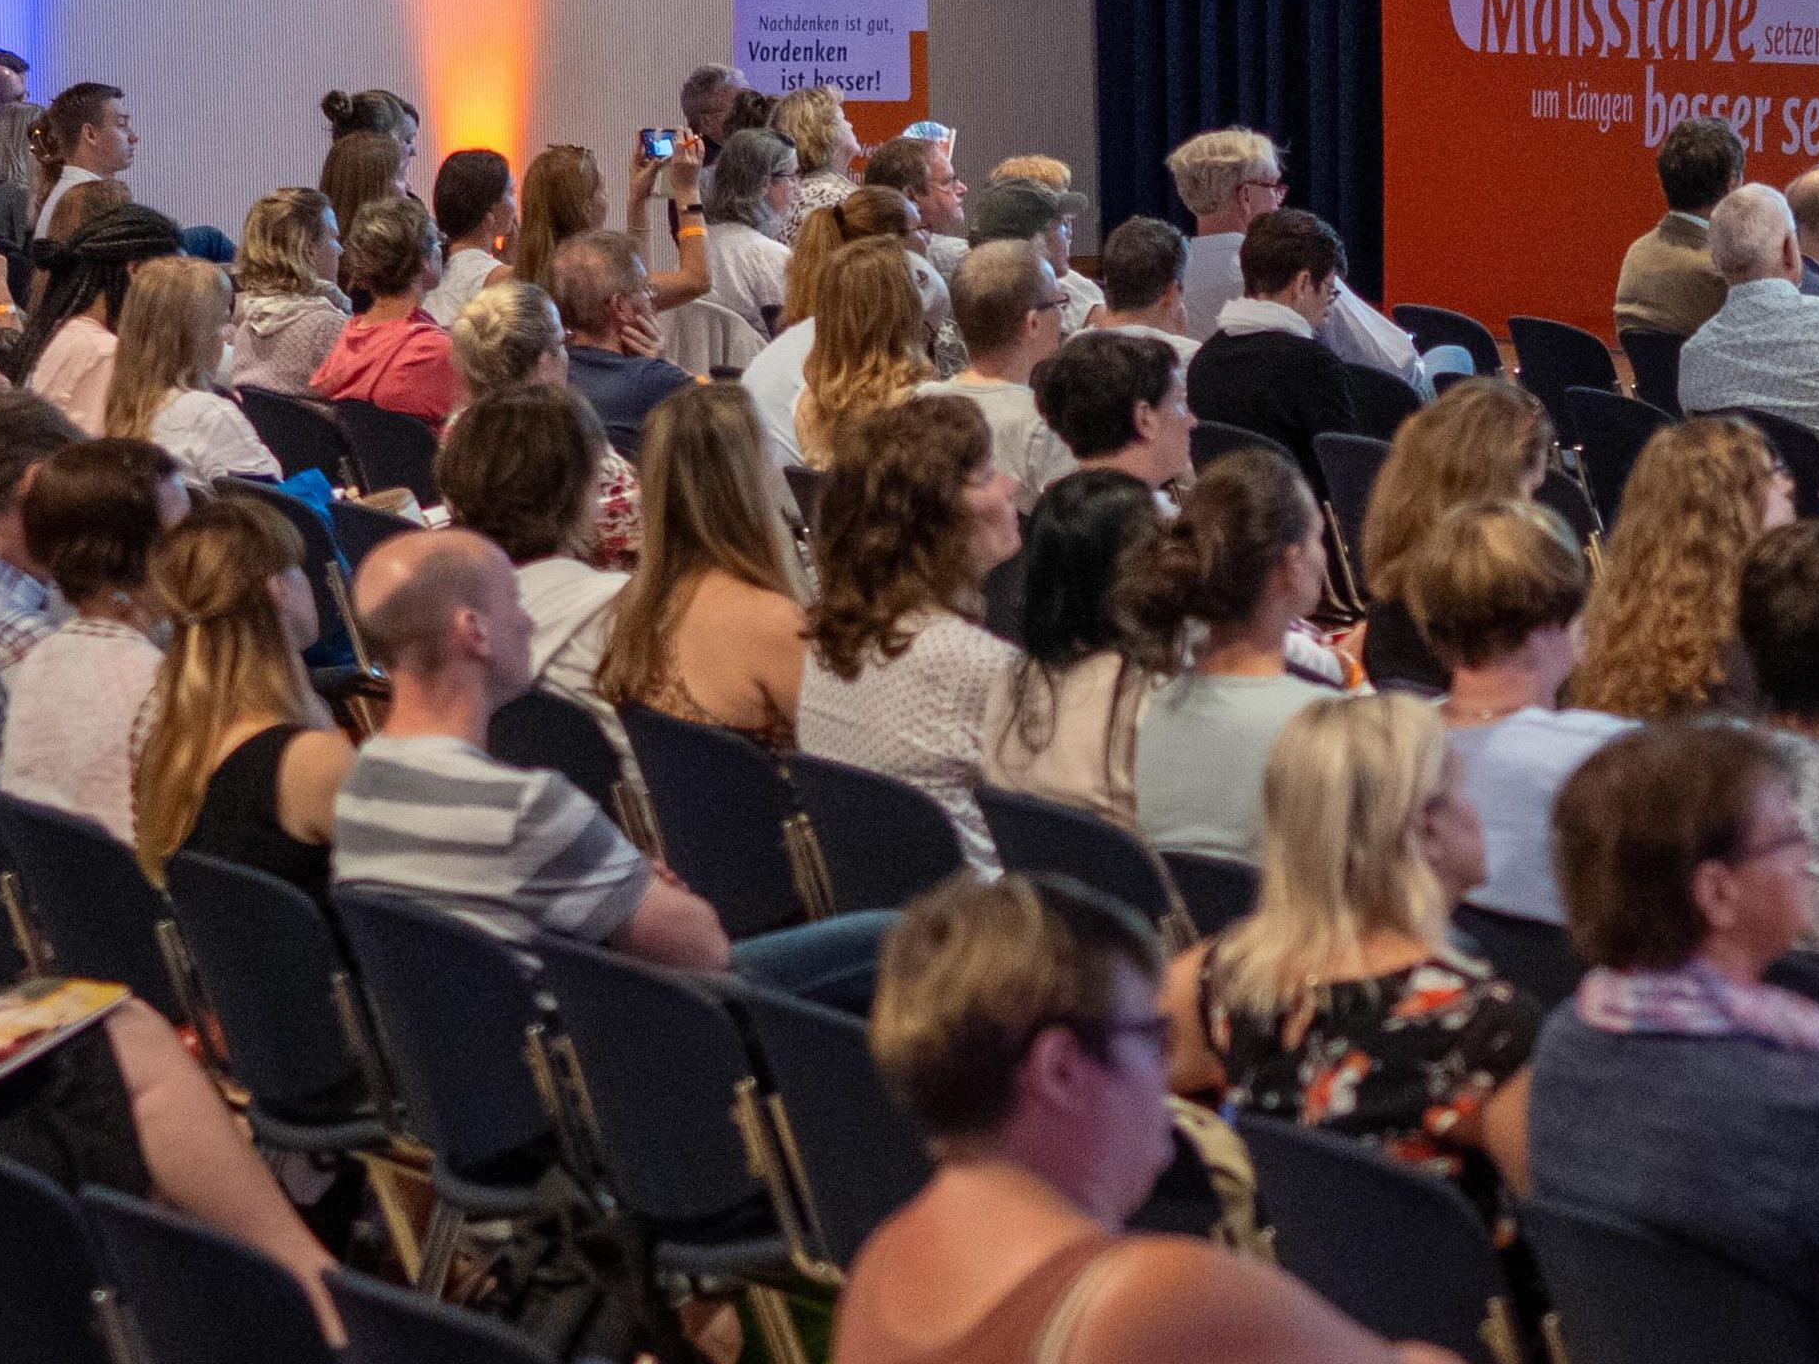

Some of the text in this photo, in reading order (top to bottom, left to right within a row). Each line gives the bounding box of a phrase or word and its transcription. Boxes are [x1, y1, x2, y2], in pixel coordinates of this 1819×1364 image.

[759, 13, 894, 37] Nachdenken ist gut,
[748, 38, 848, 62] Vordenken
[781, 67, 806, 91] ist
[1531, 88, 1560, 119] um
[1567, 81, 1633, 133] Längen
